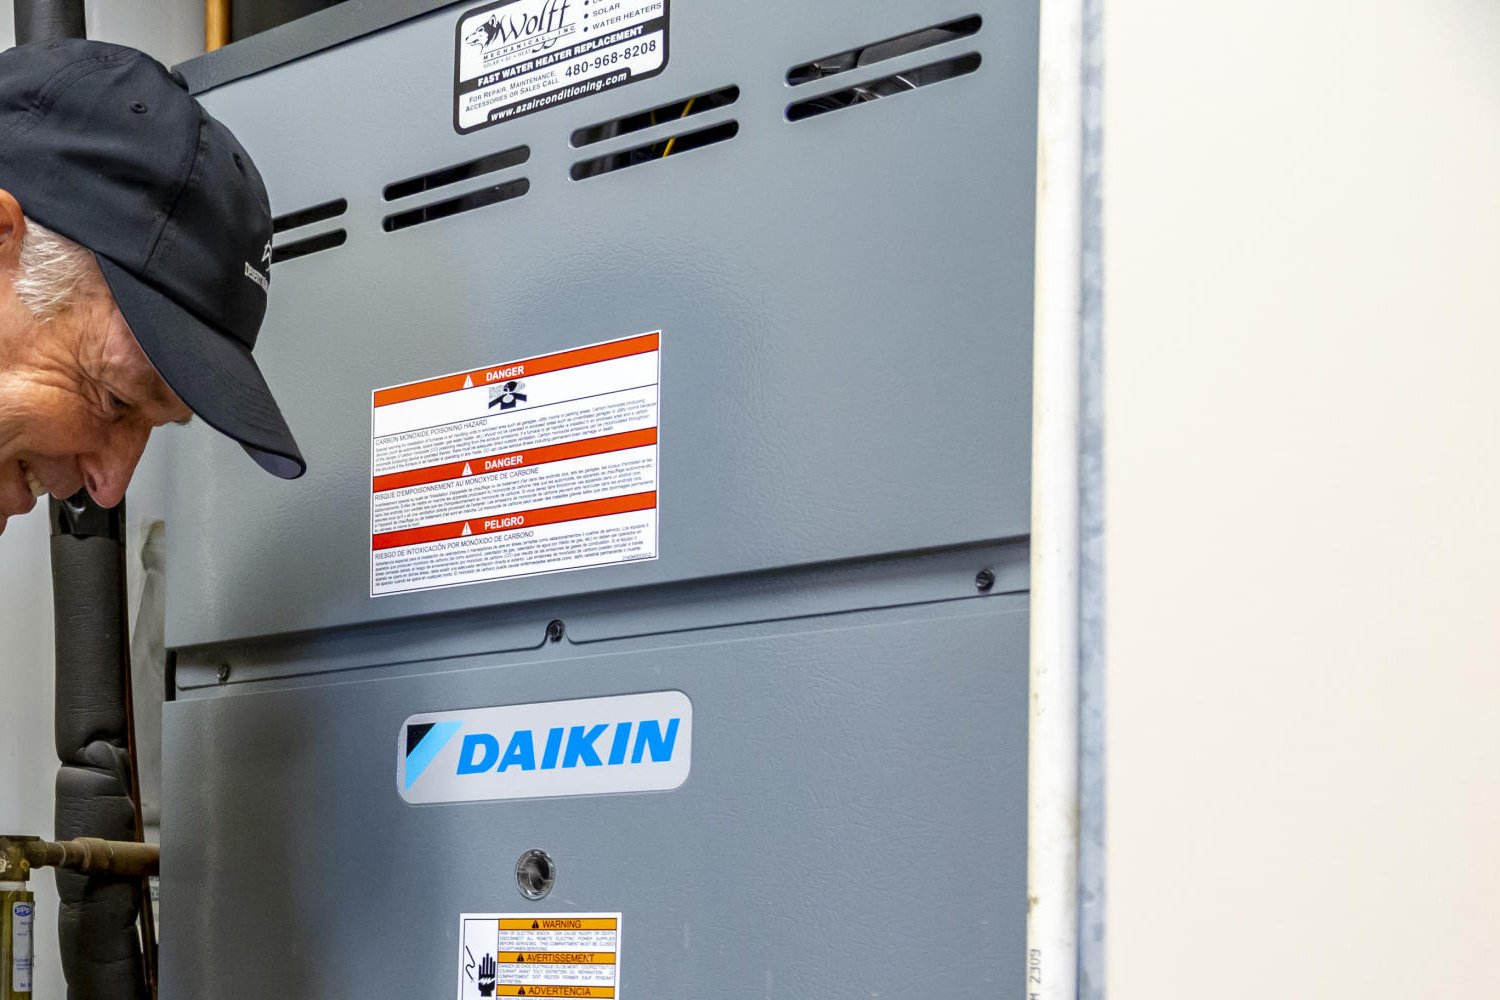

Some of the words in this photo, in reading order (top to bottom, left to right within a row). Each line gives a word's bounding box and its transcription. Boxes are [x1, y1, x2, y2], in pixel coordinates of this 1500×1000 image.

[592, 3, 620, 17] SOLAR
[592, 16, 622, 30] WATER
[623, 2, 662, 20] HEATERS
[499, 0, 571, 44] Wolff
[477, 72, 501, 87] FAST
[502, 61, 534, 79] WATER
[535, 48, 573, 68] HEATER
[573, 25, 644, 56] REPLACEMENT
[565, 39, 657, 78] 480-968-8208
[491, 72, 628, 122] www.azairconditioning.com
[485, 366, 525, 381] DANGER
[375, 435, 399, 446] CARBON
[399, 429, 429, 442] MONOXIDE
[430, 422, 462, 436] POISONING
[463, 418, 487, 429] HAZARD
[484, 455, 524, 470] DANGER
[455, 479, 464, 488] AU
[499, 471, 507, 480] DE
[484, 516, 525, 530] PELIGRO
[396, 549, 405, 557] DE
[447, 540, 460, 549] POR
[493, 534, 502, 542] DE
[456, 718, 680, 776] DAIKIN
[542, 919, 582, 930] WARNING
[526, 953, 595, 964] AVERTISSEMENT
[528, 986, 591, 997] ADVERTENCIA
